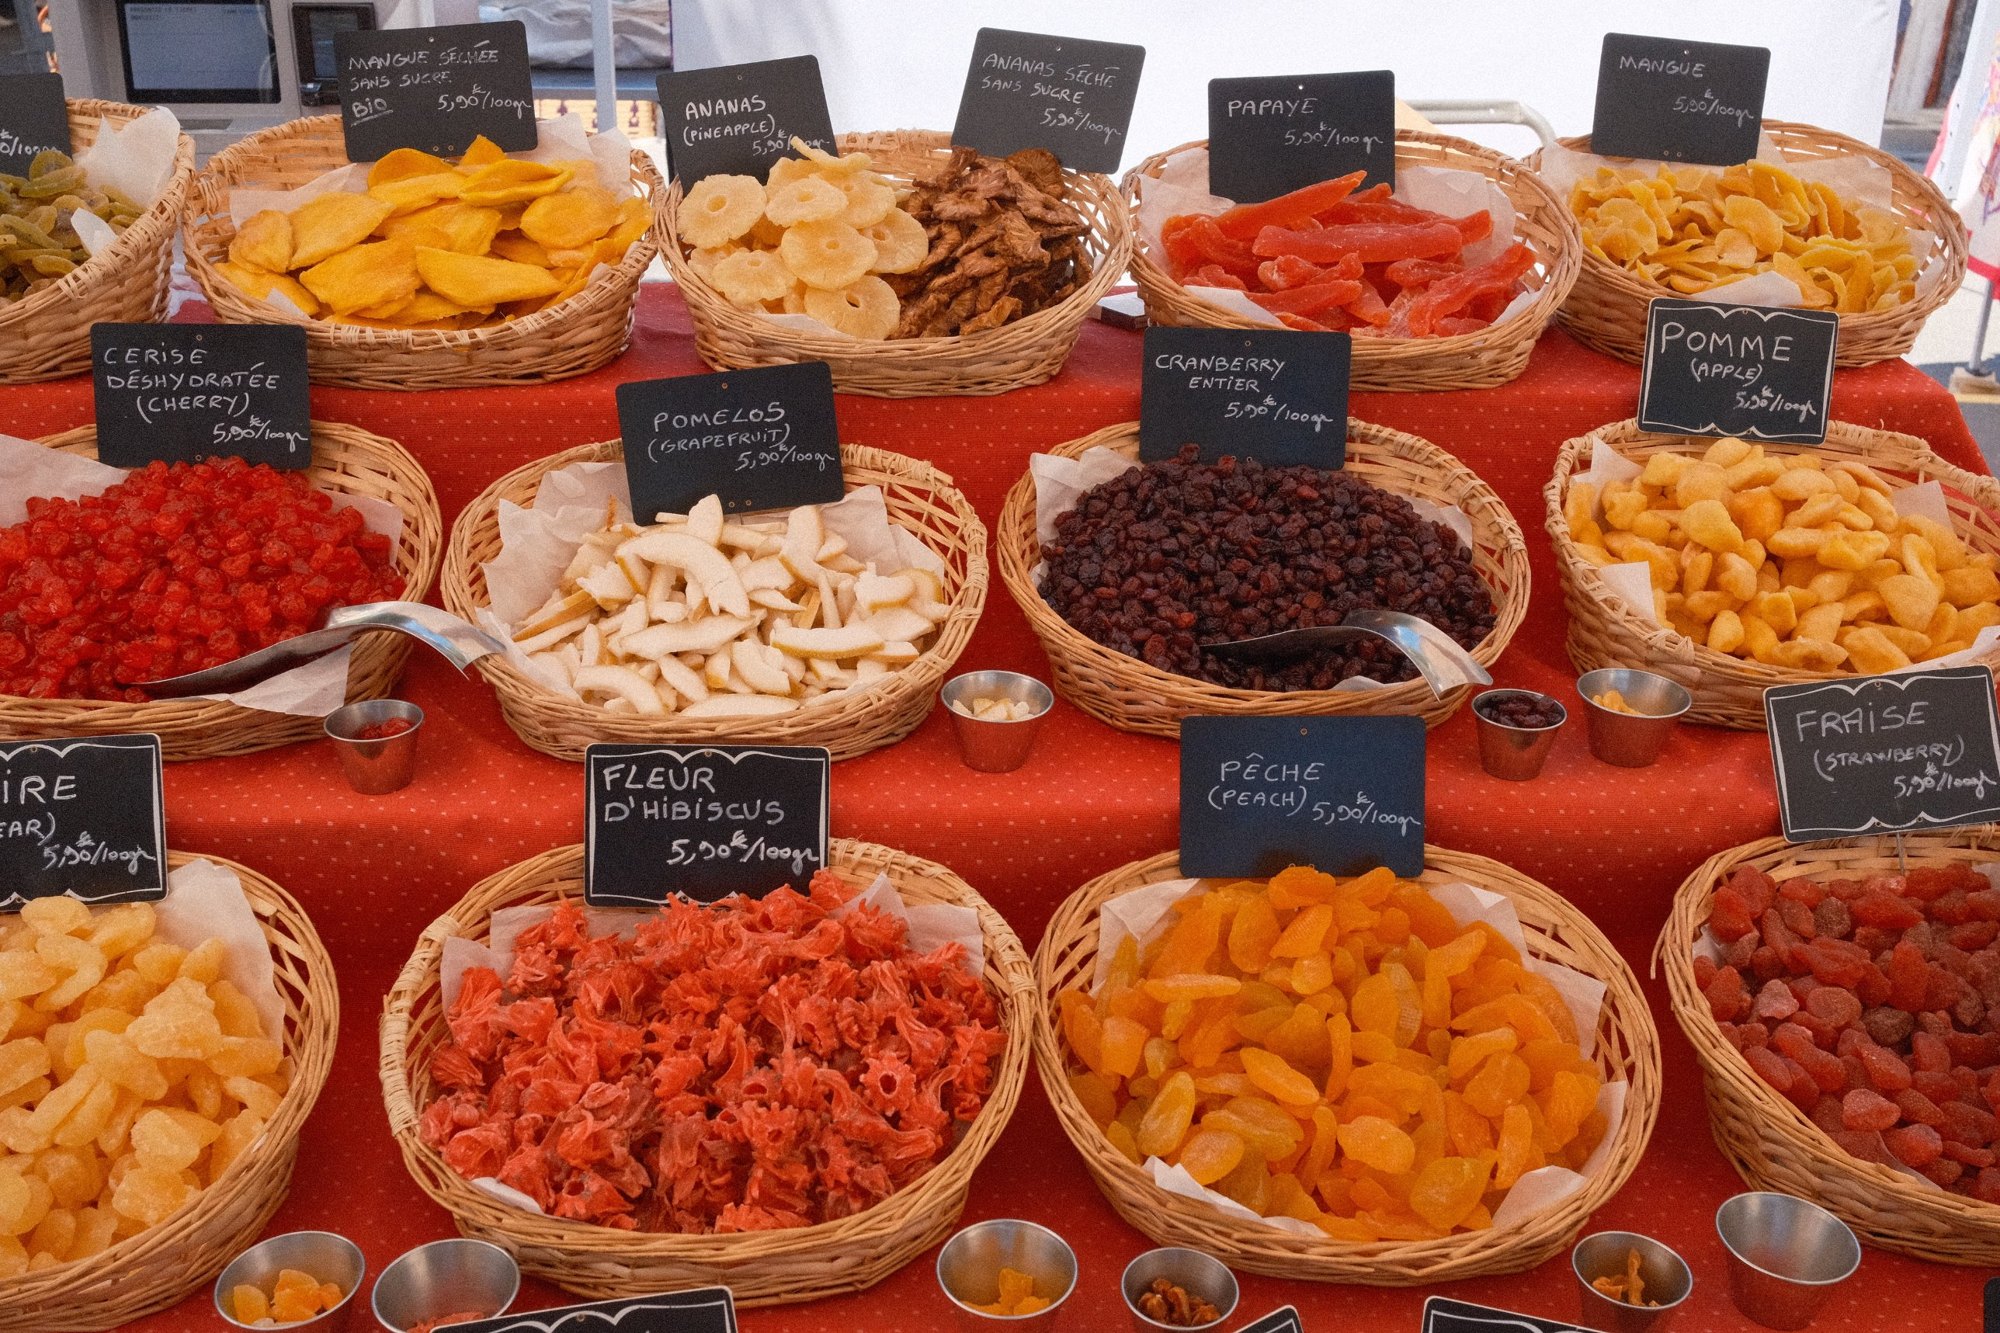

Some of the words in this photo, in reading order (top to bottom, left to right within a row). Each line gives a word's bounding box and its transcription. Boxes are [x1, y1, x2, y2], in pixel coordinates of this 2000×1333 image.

[349, 51, 430, 70] MANGUE
[982, 53, 1055, 77] ANANAS
[1619, 56, 1705, 77] MANGUE
[350, 75, 391, 92] SANS
[399, 71, 452, 87] SUCRE
[981, 76, 1022, 91] SANS
[1030, 82, 1084, 104] SUCRE
[685, 95, 766, 120] ANANAS
[1228, 98, 1318, 117] PAPAYE
[1661, 322, 1793, 361] POMME
[107, 362, 280, 390] DÉSHYDRATÉE
[1155, 354, 1285, 381] CRANBERRY
[1690, 357, 1763, 387] (APPLE)
[136, 392, 250, 424] (CHERRY)
[653, 401, 785, 432] POMELOS
[1220, 751, 1325, 782] PÊCHE
[1814, 734, 1964, 782] (STRAWBERRY)
[603, 764, 716, 793] FLEUR
[1208, 785, 1307, 816] (PEACH)
